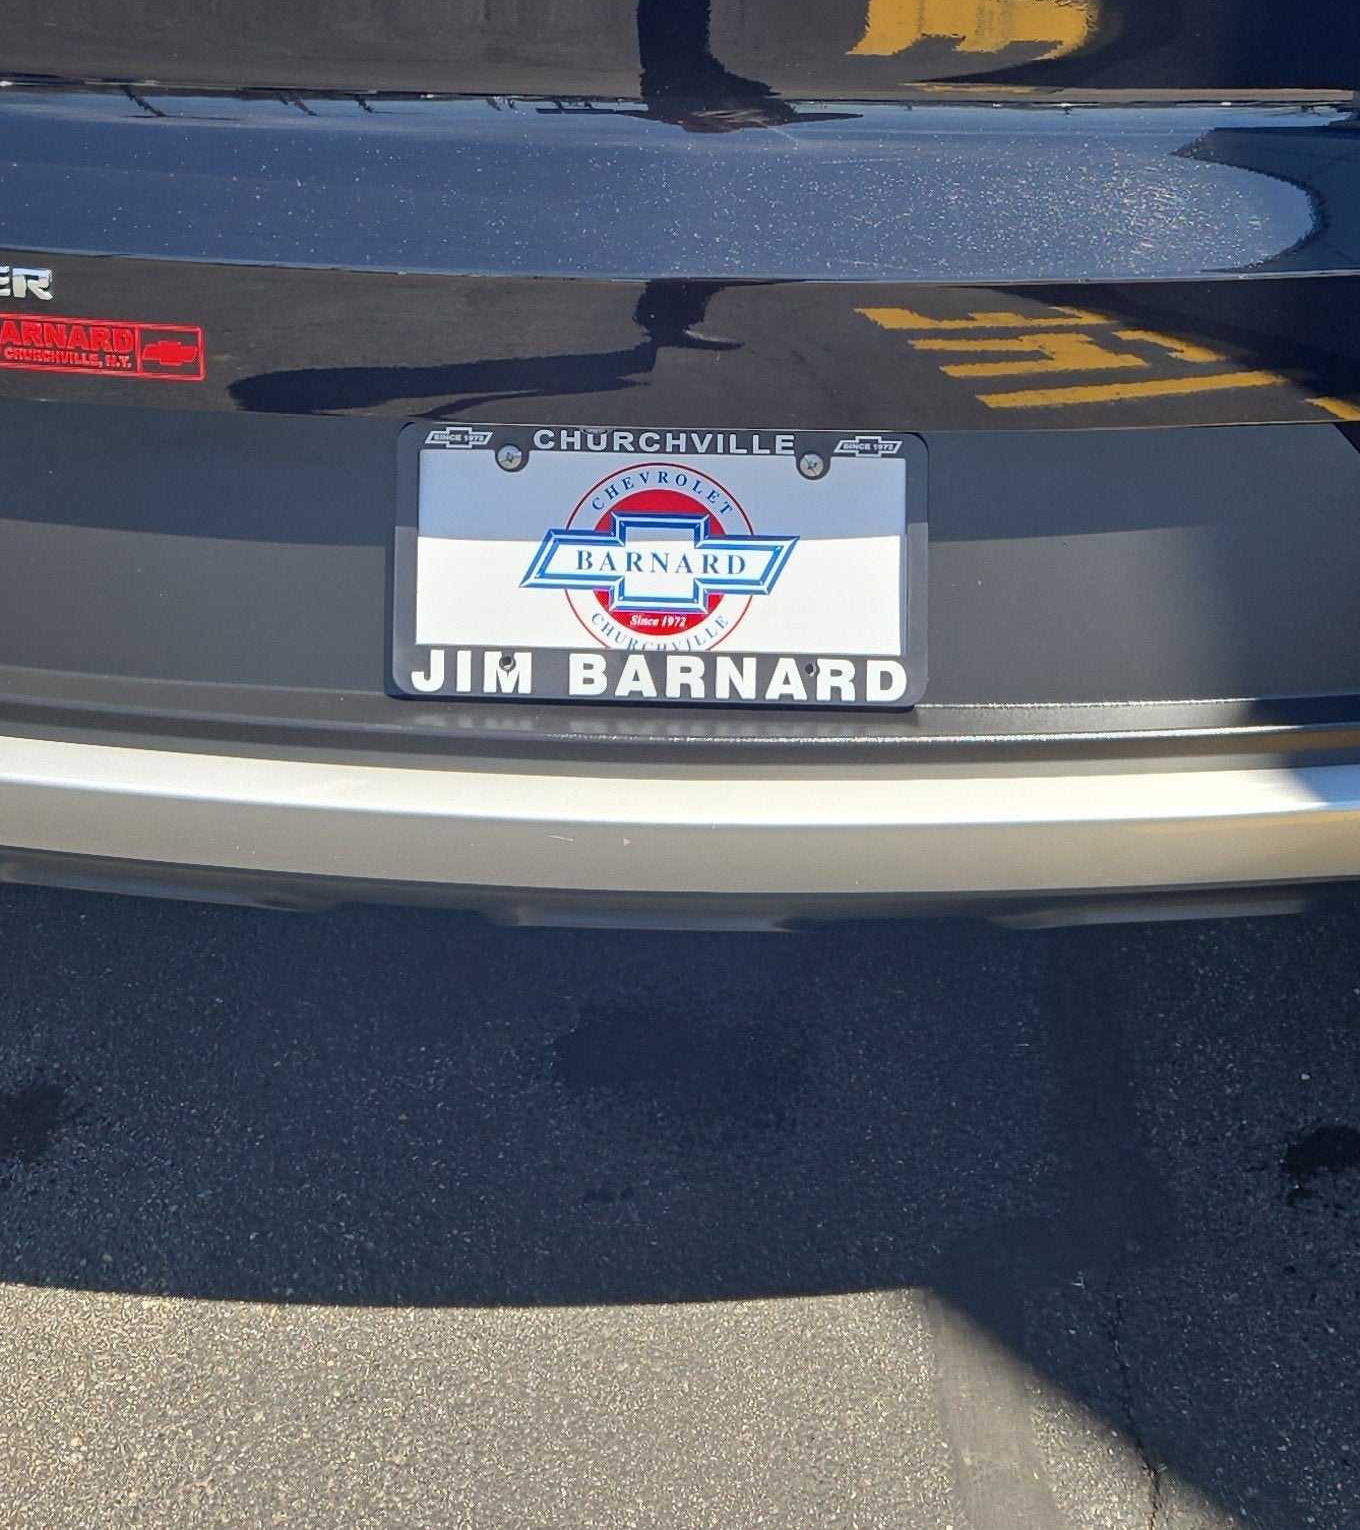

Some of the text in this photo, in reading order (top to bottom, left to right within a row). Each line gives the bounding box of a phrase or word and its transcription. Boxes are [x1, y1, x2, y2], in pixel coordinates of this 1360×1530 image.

[433, 433, 462, 442] SINCE
[532, 428, 797, 455] CHURCHVILLE
[843, 442, 871, 451] SINCE
[591, 471, 733, 516] CHEVROLET
[576, 549, 746, 575] BARNARD
[629, 614, 687, 628] Since 1972
[411, 649, 908, 702] JIM BARNARD
